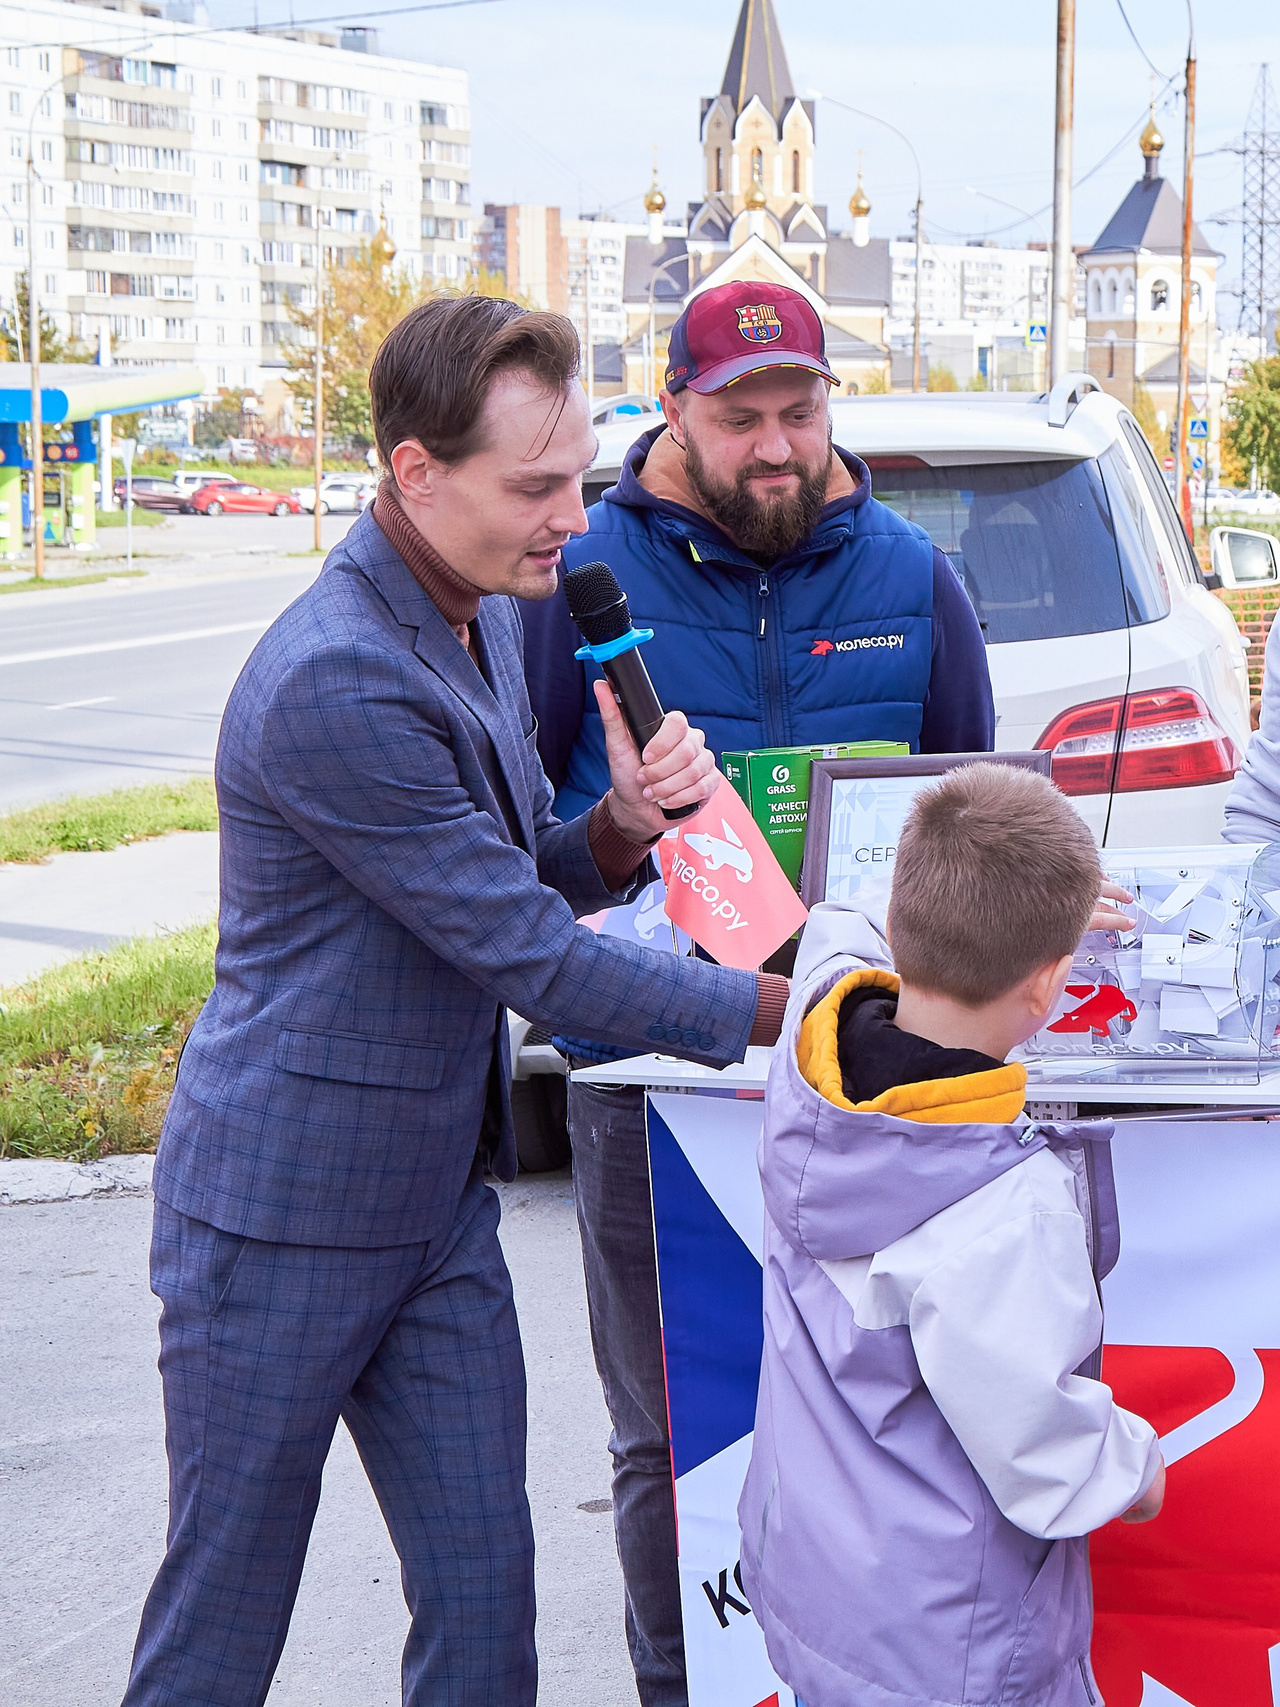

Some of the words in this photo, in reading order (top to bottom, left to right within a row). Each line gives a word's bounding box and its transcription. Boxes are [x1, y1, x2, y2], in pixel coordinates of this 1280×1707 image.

[835, 634, 904, 653] колесо.ру
[766, 784, 796, 795] GRASS
[855, 847, 897, 863] СЕР
[702, 1559, 751, 1629] К
